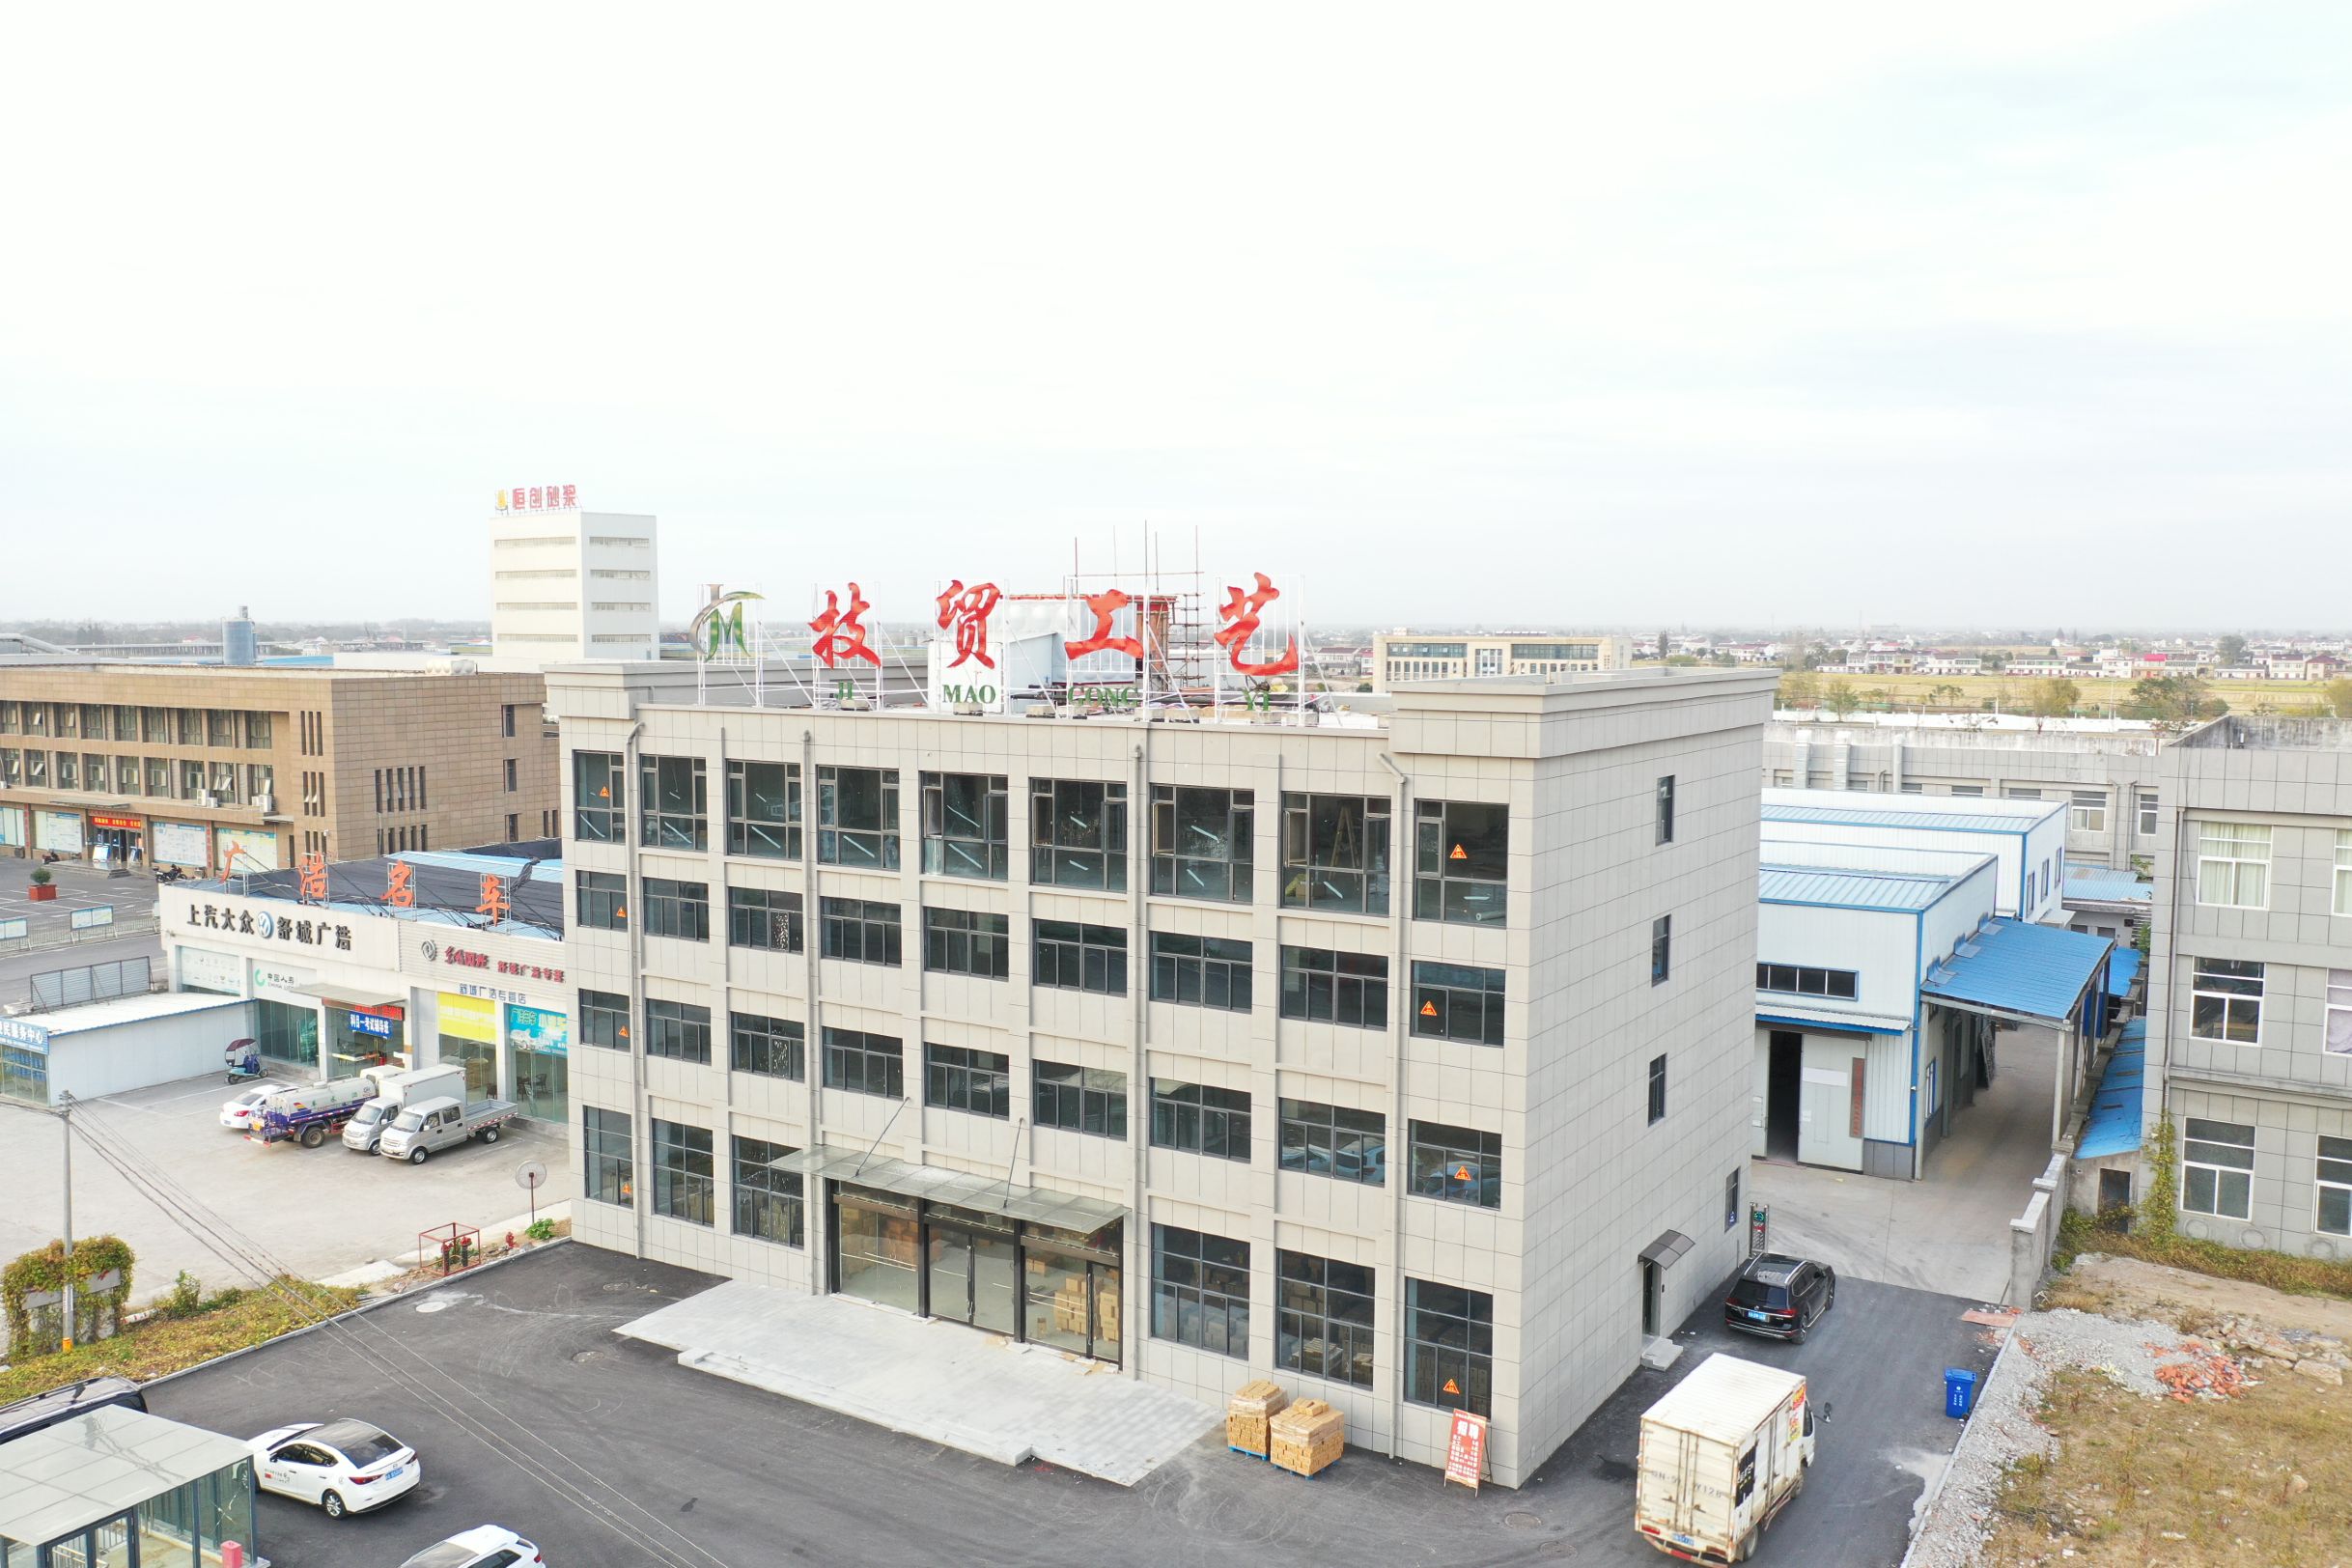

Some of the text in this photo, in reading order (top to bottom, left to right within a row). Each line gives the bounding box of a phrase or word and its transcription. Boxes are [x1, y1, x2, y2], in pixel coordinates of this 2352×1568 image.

[808, 572, 1299, 676] 技贸工艺
[942, 684, 996, 704] MAO
[1068, 686, 1138, 707] GONG
[217, 840, 511, 927] 广浩名车
[186, 904, 352, 951] 上汽大众 舒城广浩
